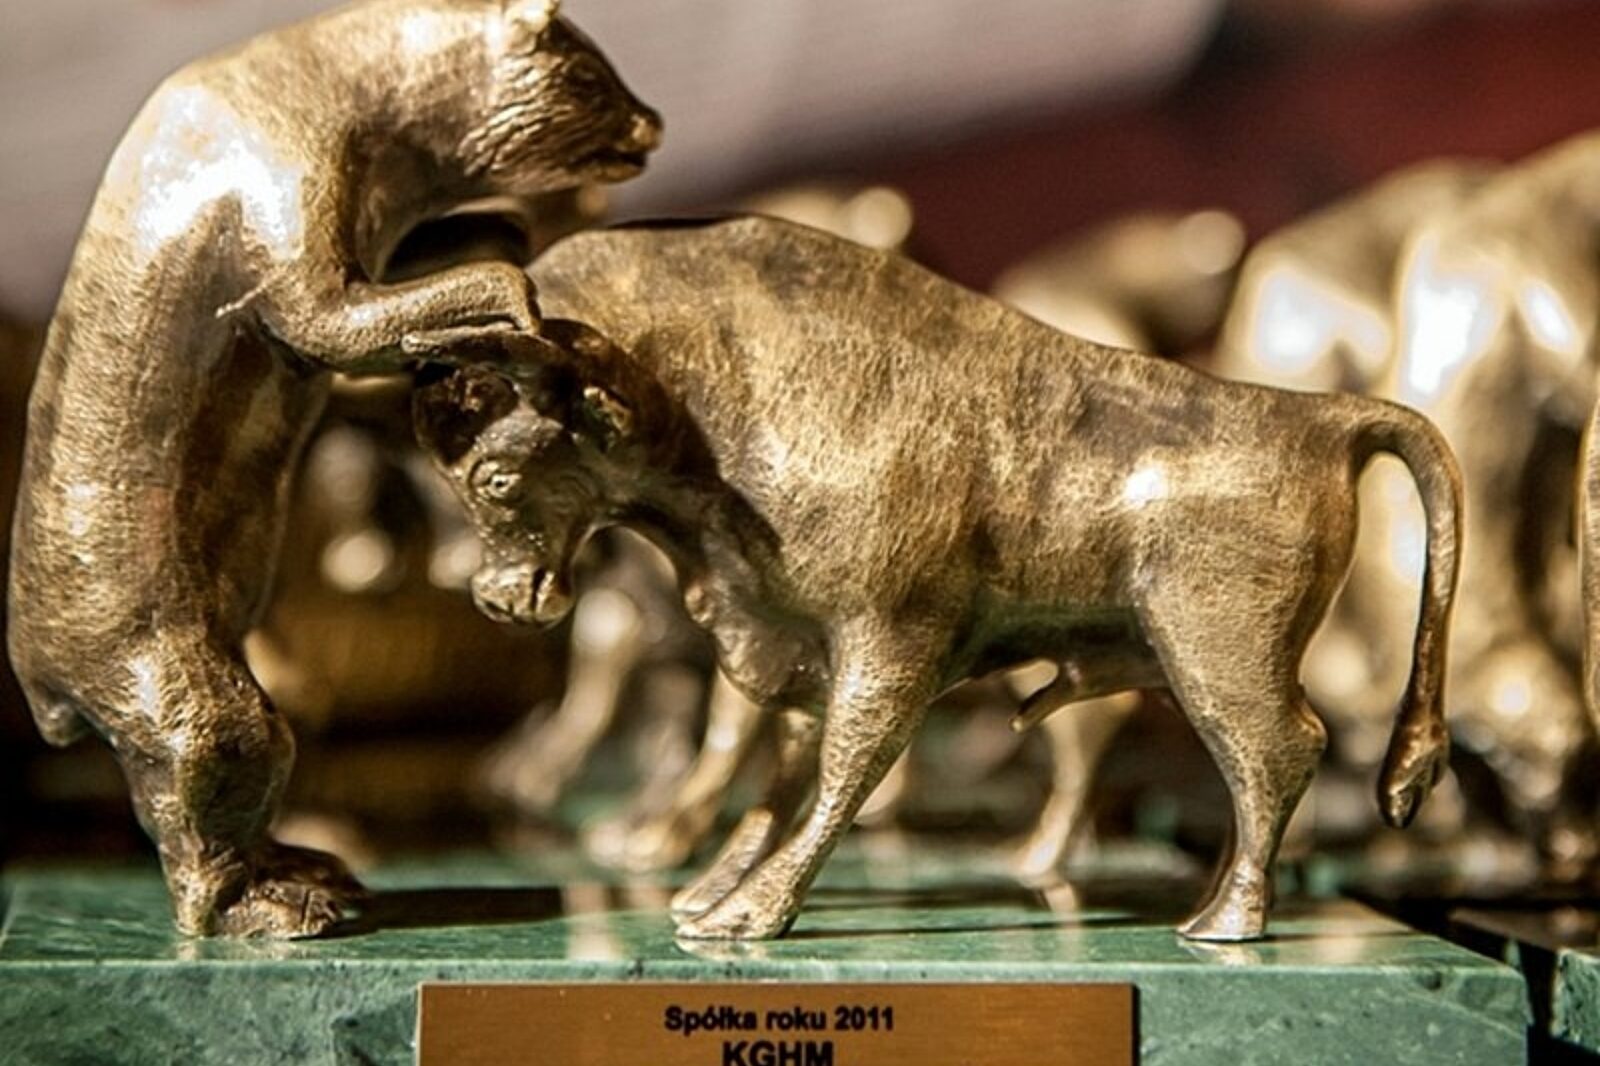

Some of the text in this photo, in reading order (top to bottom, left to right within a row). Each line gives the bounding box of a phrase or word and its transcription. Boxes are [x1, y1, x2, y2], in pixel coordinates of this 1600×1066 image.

[664, 1005, 894, 1037] Spółka roku 2011
[722, 1040, 835, 1066] KGHM
